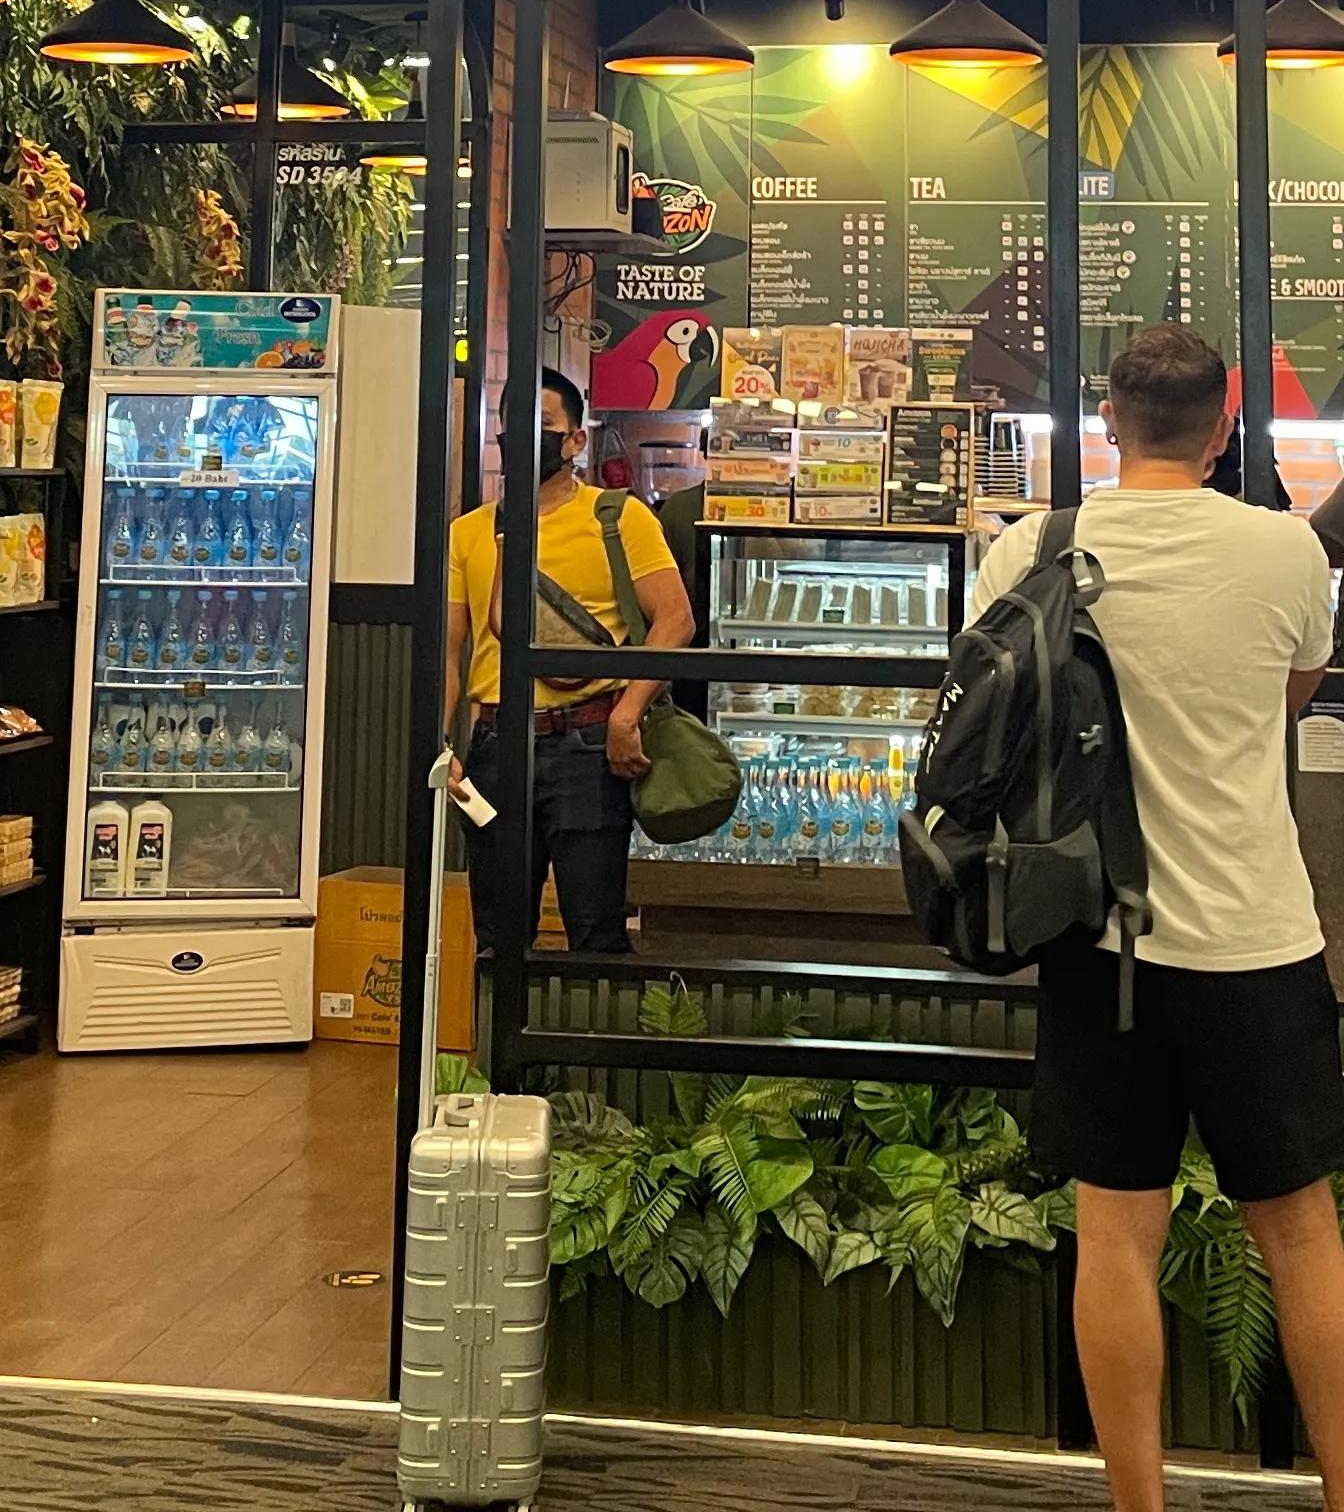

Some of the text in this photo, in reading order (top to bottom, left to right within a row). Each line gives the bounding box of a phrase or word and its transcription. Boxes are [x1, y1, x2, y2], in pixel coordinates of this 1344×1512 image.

[276, 165, 305, 185] SD
[751, 176, 818, 199] COFFEE
[909, 176, 946, 200] TEA
[616, 264, 705, 281] TASTE OF
[616, 282, 705, 301] NATURE
